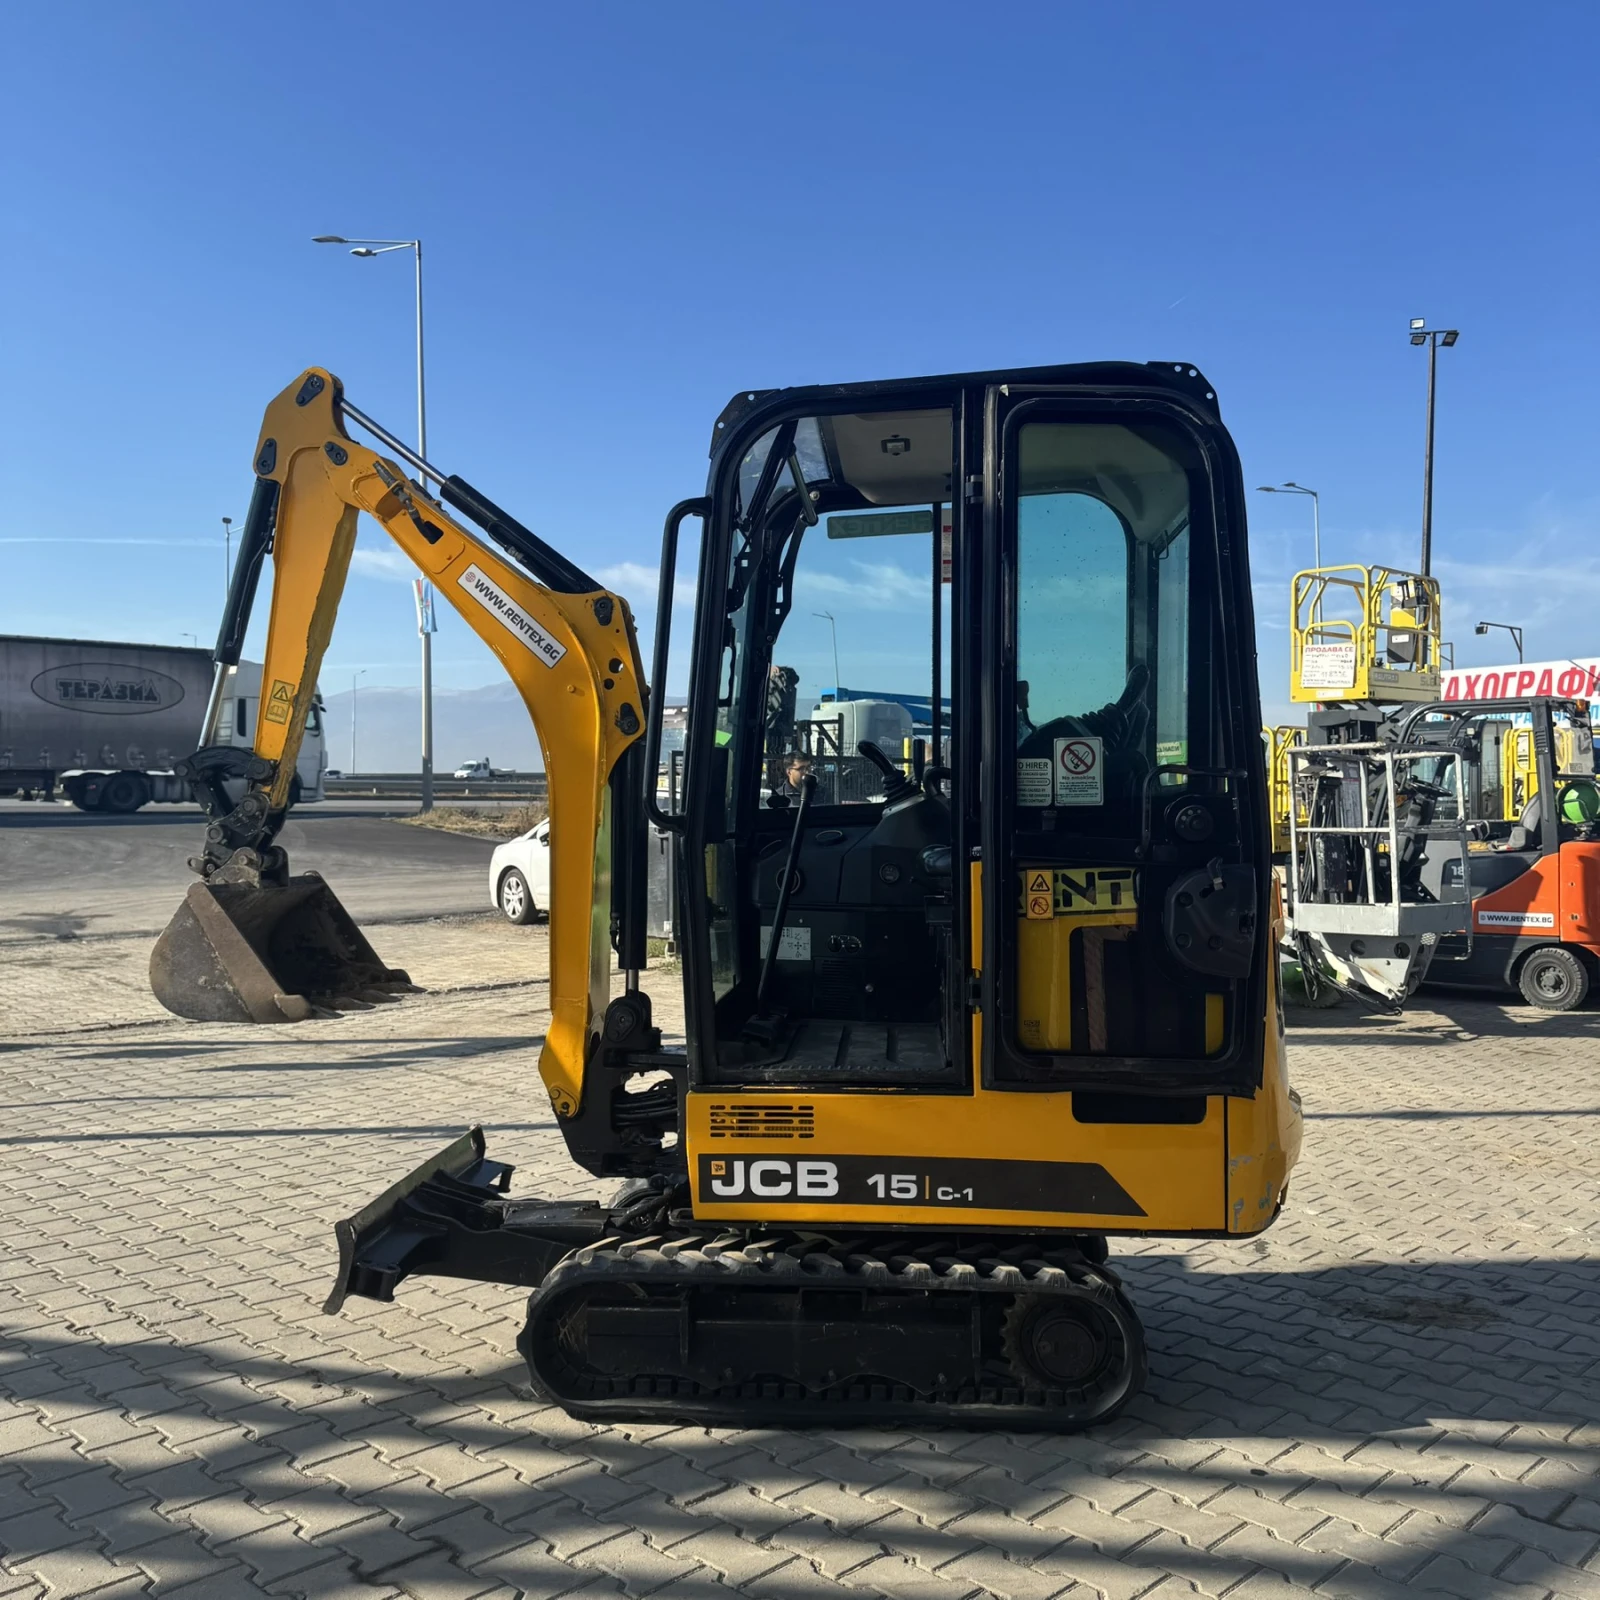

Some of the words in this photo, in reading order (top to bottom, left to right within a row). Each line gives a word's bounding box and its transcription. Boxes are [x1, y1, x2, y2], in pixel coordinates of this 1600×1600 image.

[474, 579, 560, 660] WWW.RENTEX.BG
[1440, 665, 1600, 702] АХОГРАФ
[1025, 761, 1049, 769] HIRER
[1486, 914, 1553, 924] WWW.RENTEX.BG
[711, 1160, 840, 1197] JCB
[866, 1174, 918, 1199] 15
[936, 1187, 974, 1201] C-1
